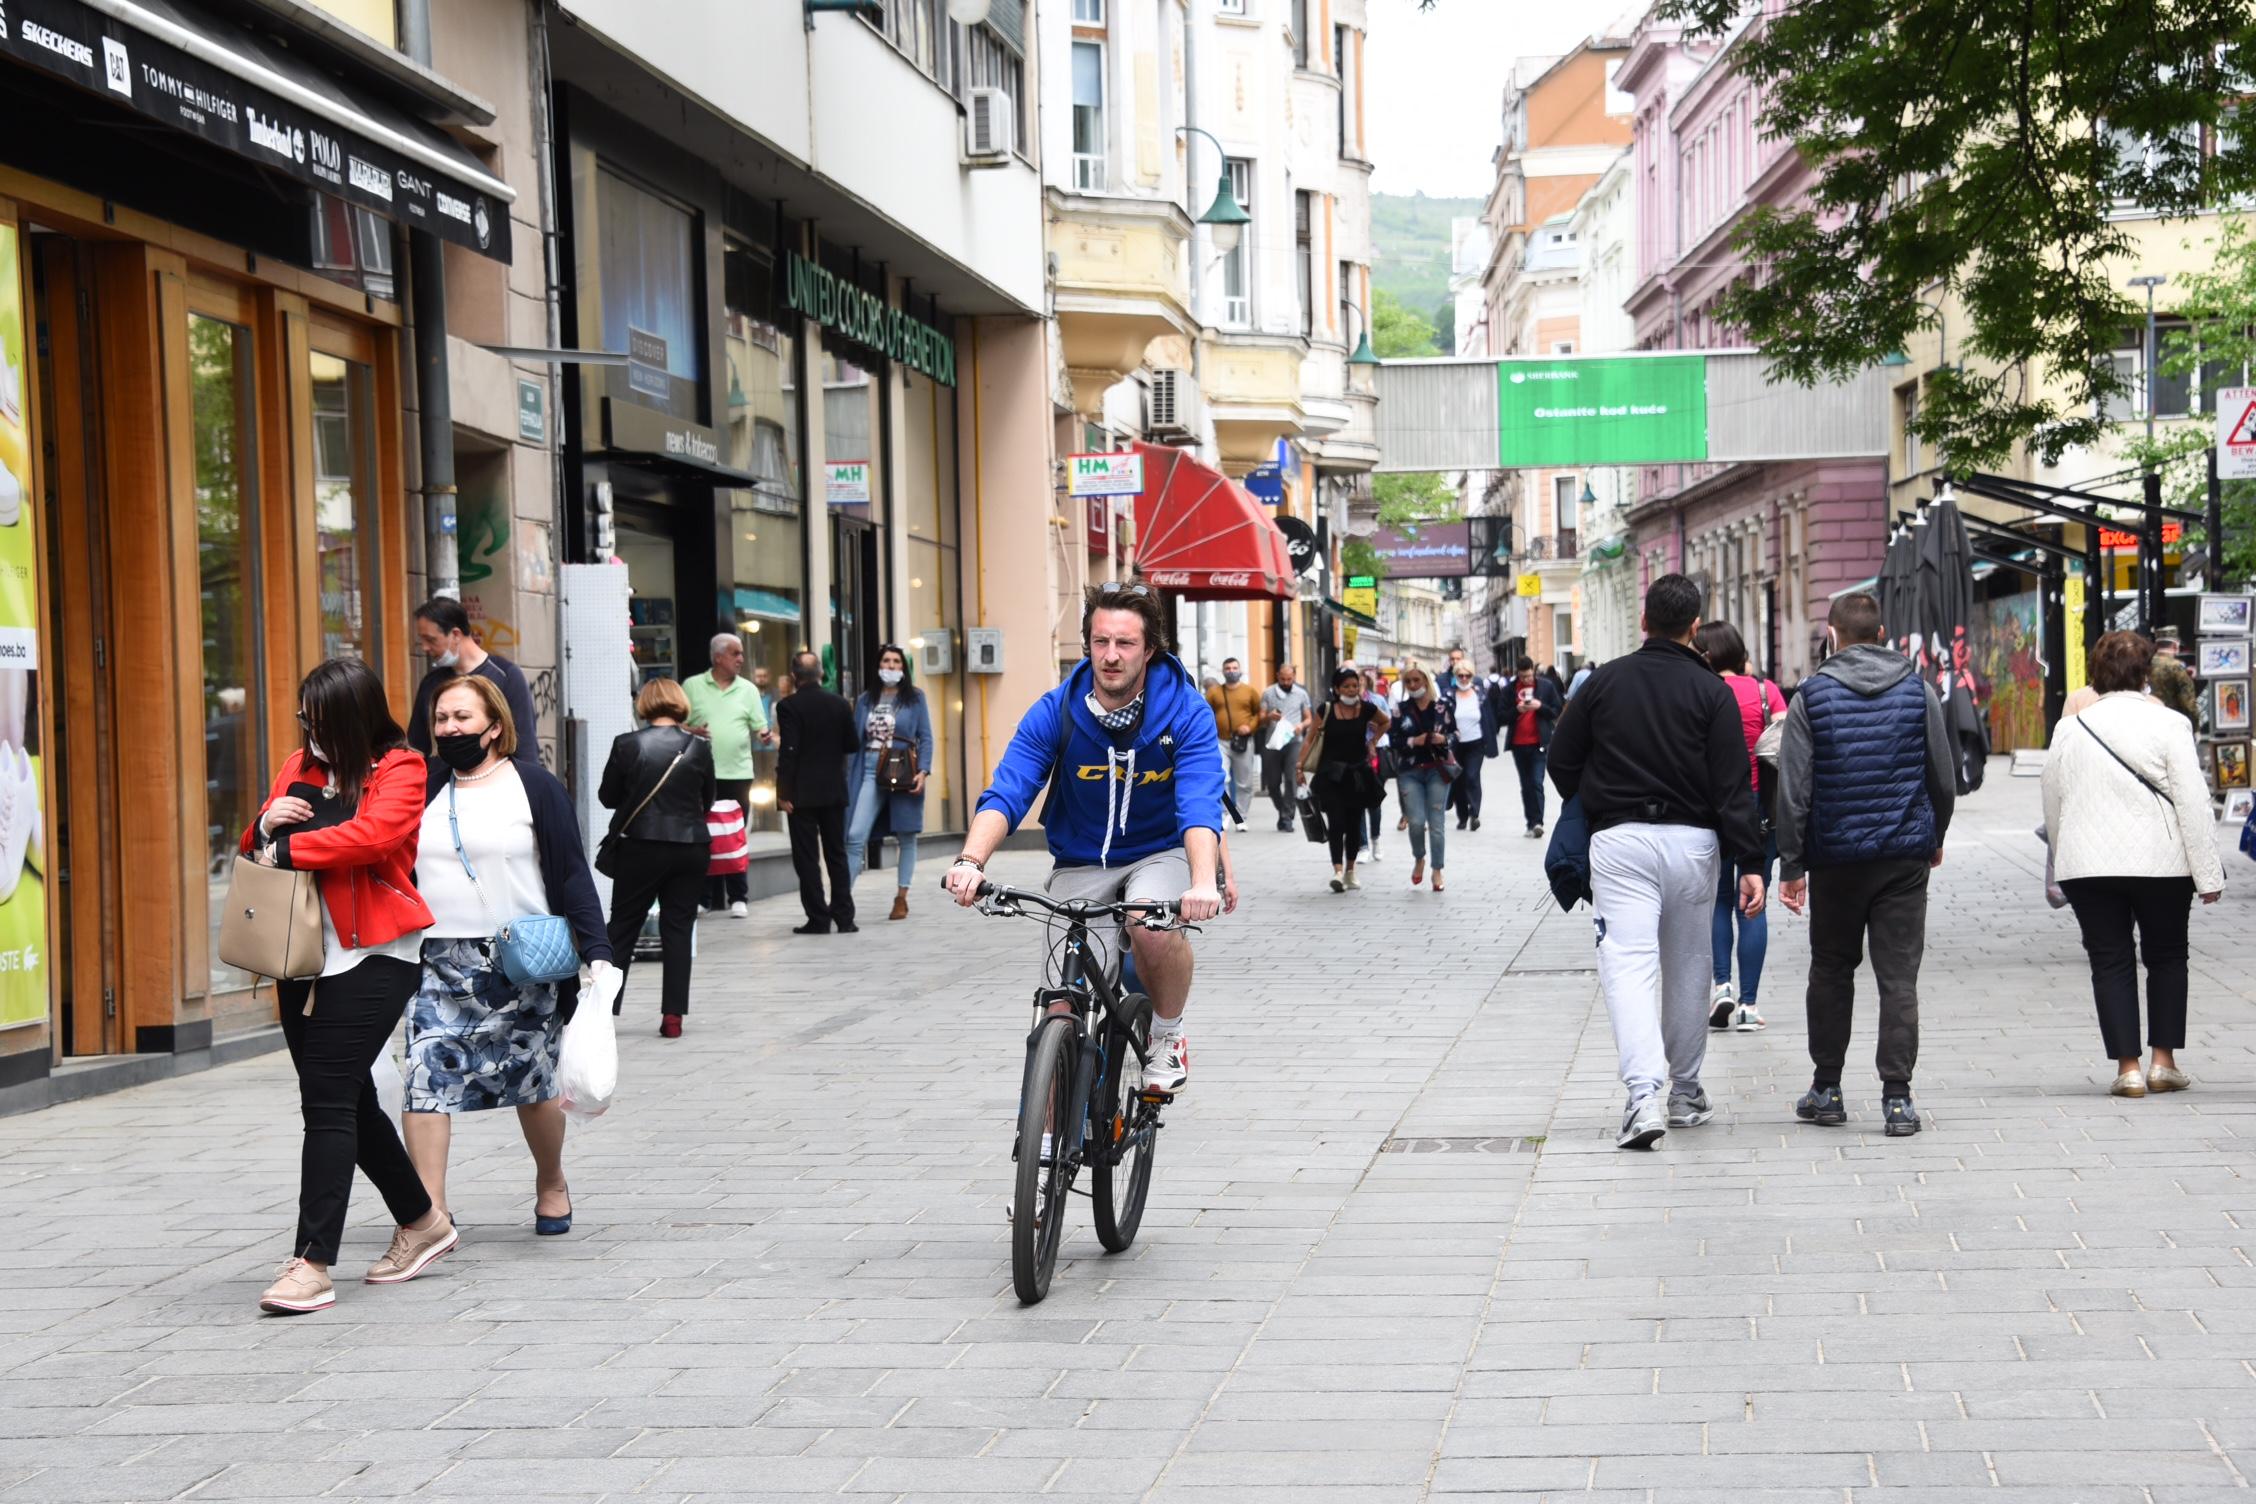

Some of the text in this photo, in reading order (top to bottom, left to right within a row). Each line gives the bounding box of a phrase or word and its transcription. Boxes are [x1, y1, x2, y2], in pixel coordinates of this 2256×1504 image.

[22, 19, 94, 68] SKECHERS
[141, 62, 238, 123] TOMMY HILFIGER
[246, 105, 293, 159] Timberland
[310, 129, 341, 172] POLO
[397, 169, 432, 200] GANT
[787, 250, 957, 389] UNITED COLORS OF BENETTON
[1534, 402, 1668, 418] Ostanite kod kuće
[666, 431, 684, 455] news
[685, 429, 692, 456] &
[2231, 447, 2256, 457] BEW
[1078, 458, 1109, 474] HM
[1150, 571, 1191, 587] Coca-Cola
[1208, 571, 1251, 587] Coca-Cola
[1160, 735, 1173, 746] HH
